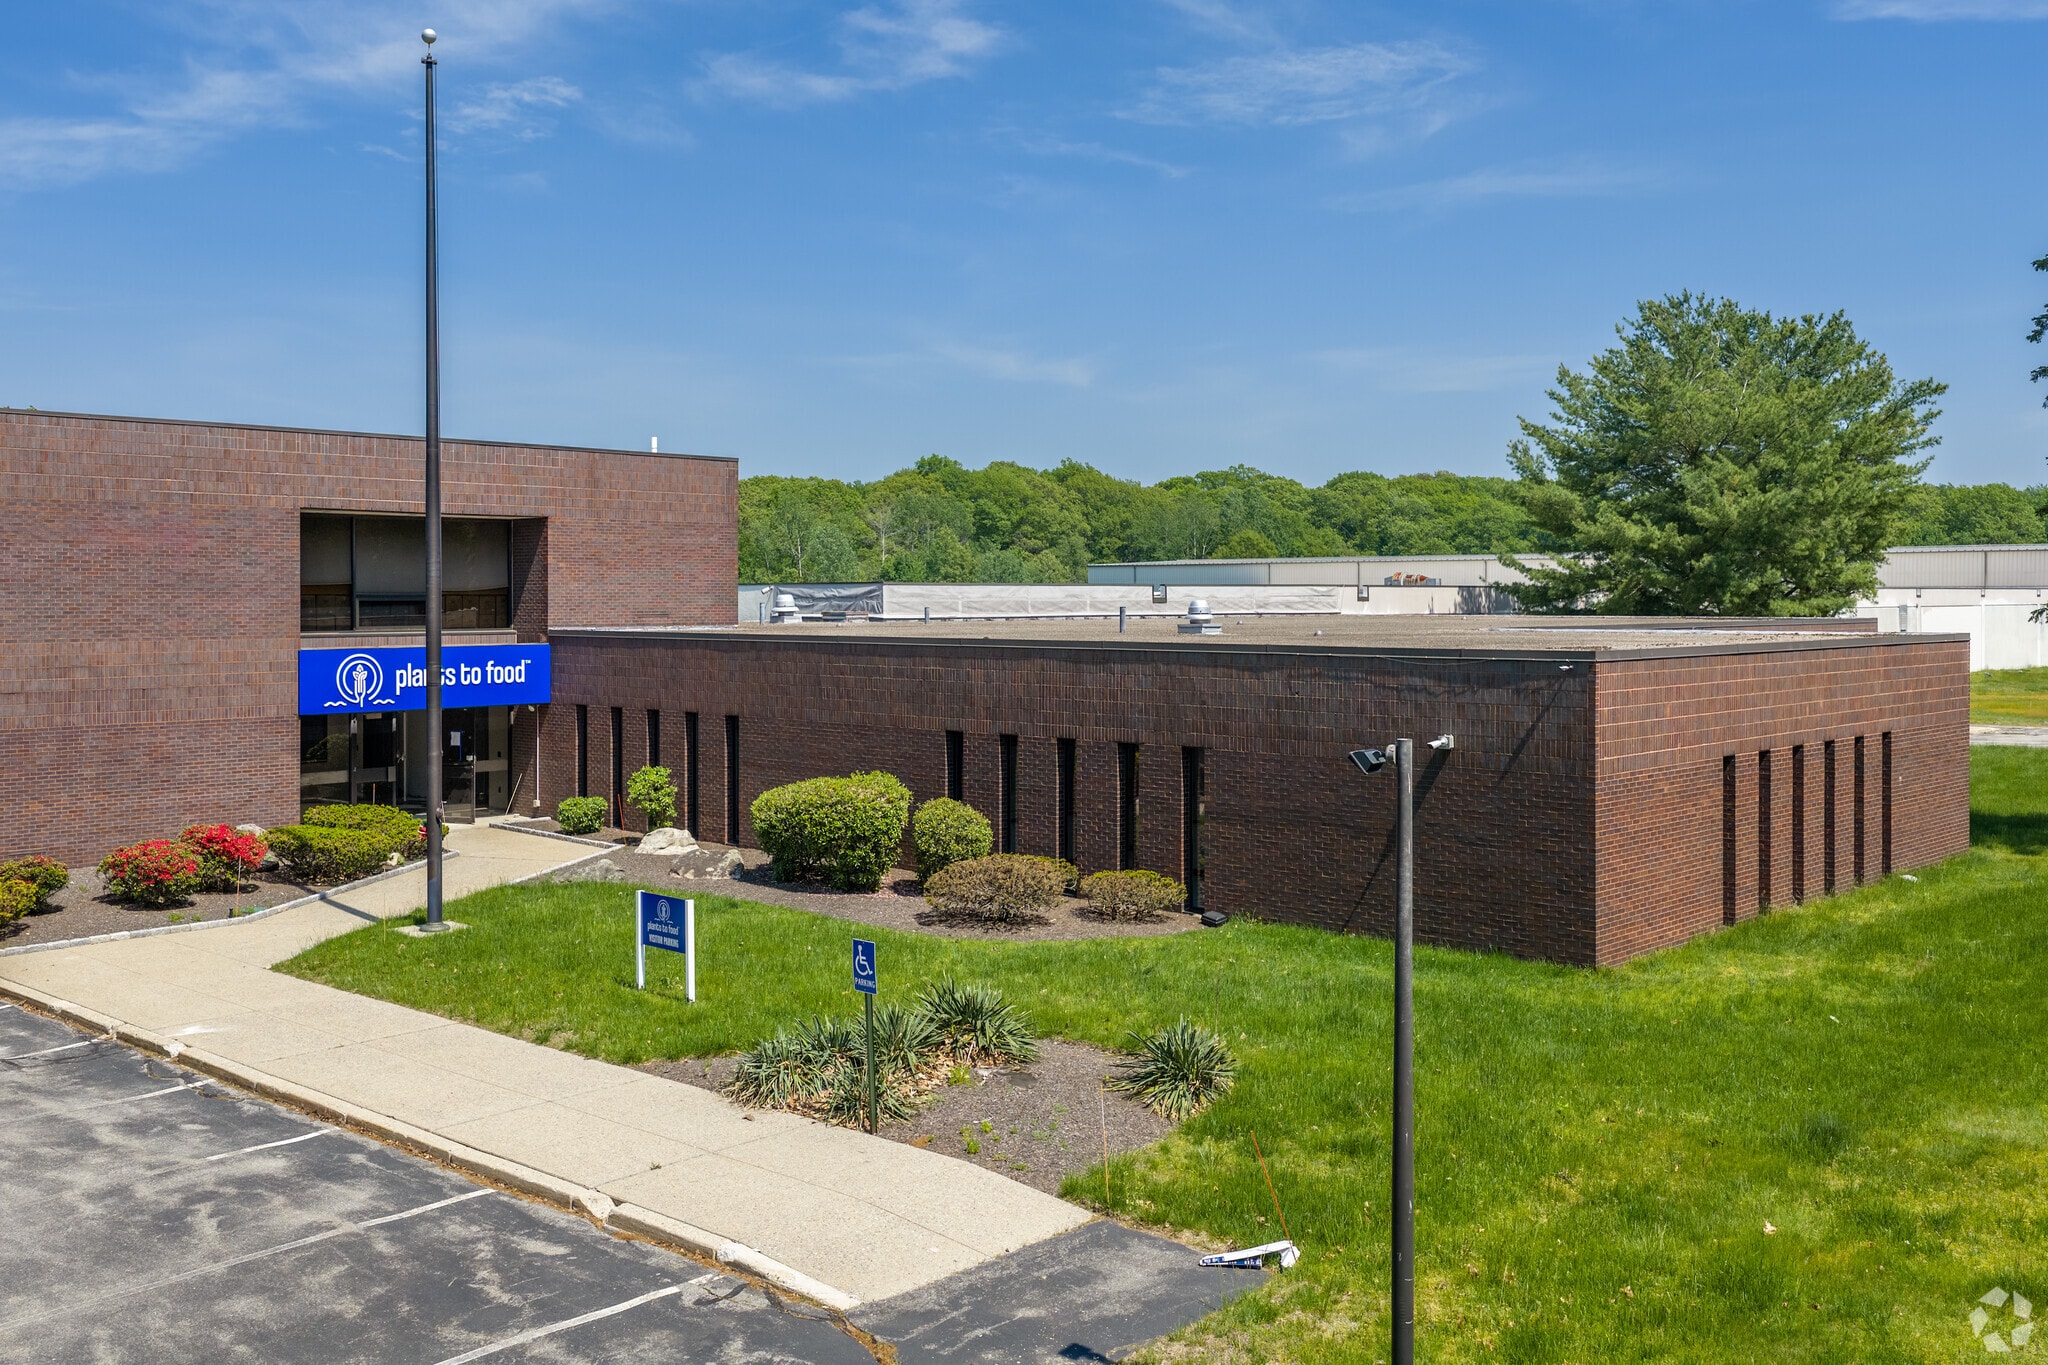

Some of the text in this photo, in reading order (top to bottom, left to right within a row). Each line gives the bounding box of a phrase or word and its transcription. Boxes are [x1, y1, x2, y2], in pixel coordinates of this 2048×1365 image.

[395, 662, 456, 696] plas
[460, 663, 482, 685] to
[662, 924, 668, 933] to
[663, 936, 679, 948] PARKING
[855, 977, 875, 989] PARKING
